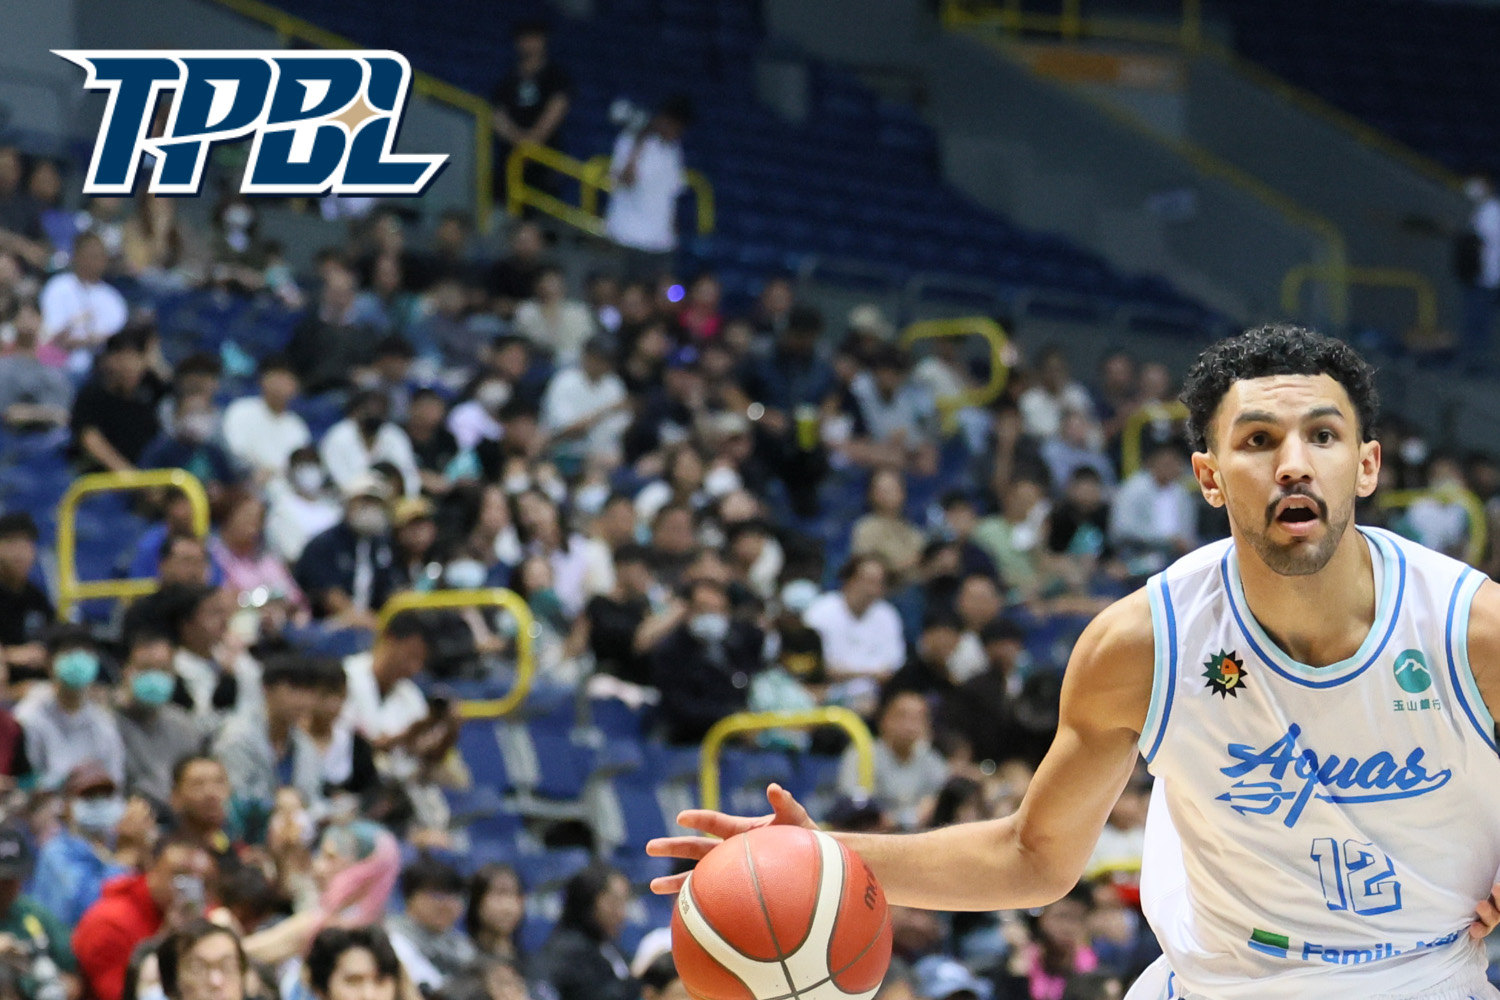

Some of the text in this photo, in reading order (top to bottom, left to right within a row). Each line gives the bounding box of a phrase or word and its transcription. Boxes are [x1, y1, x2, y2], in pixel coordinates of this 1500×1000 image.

[1393, 698, 1441, 711] 玉山銀行
[1220, 722, 1452, 829] Aquas
[1310, 837, 1403, 917] 12
